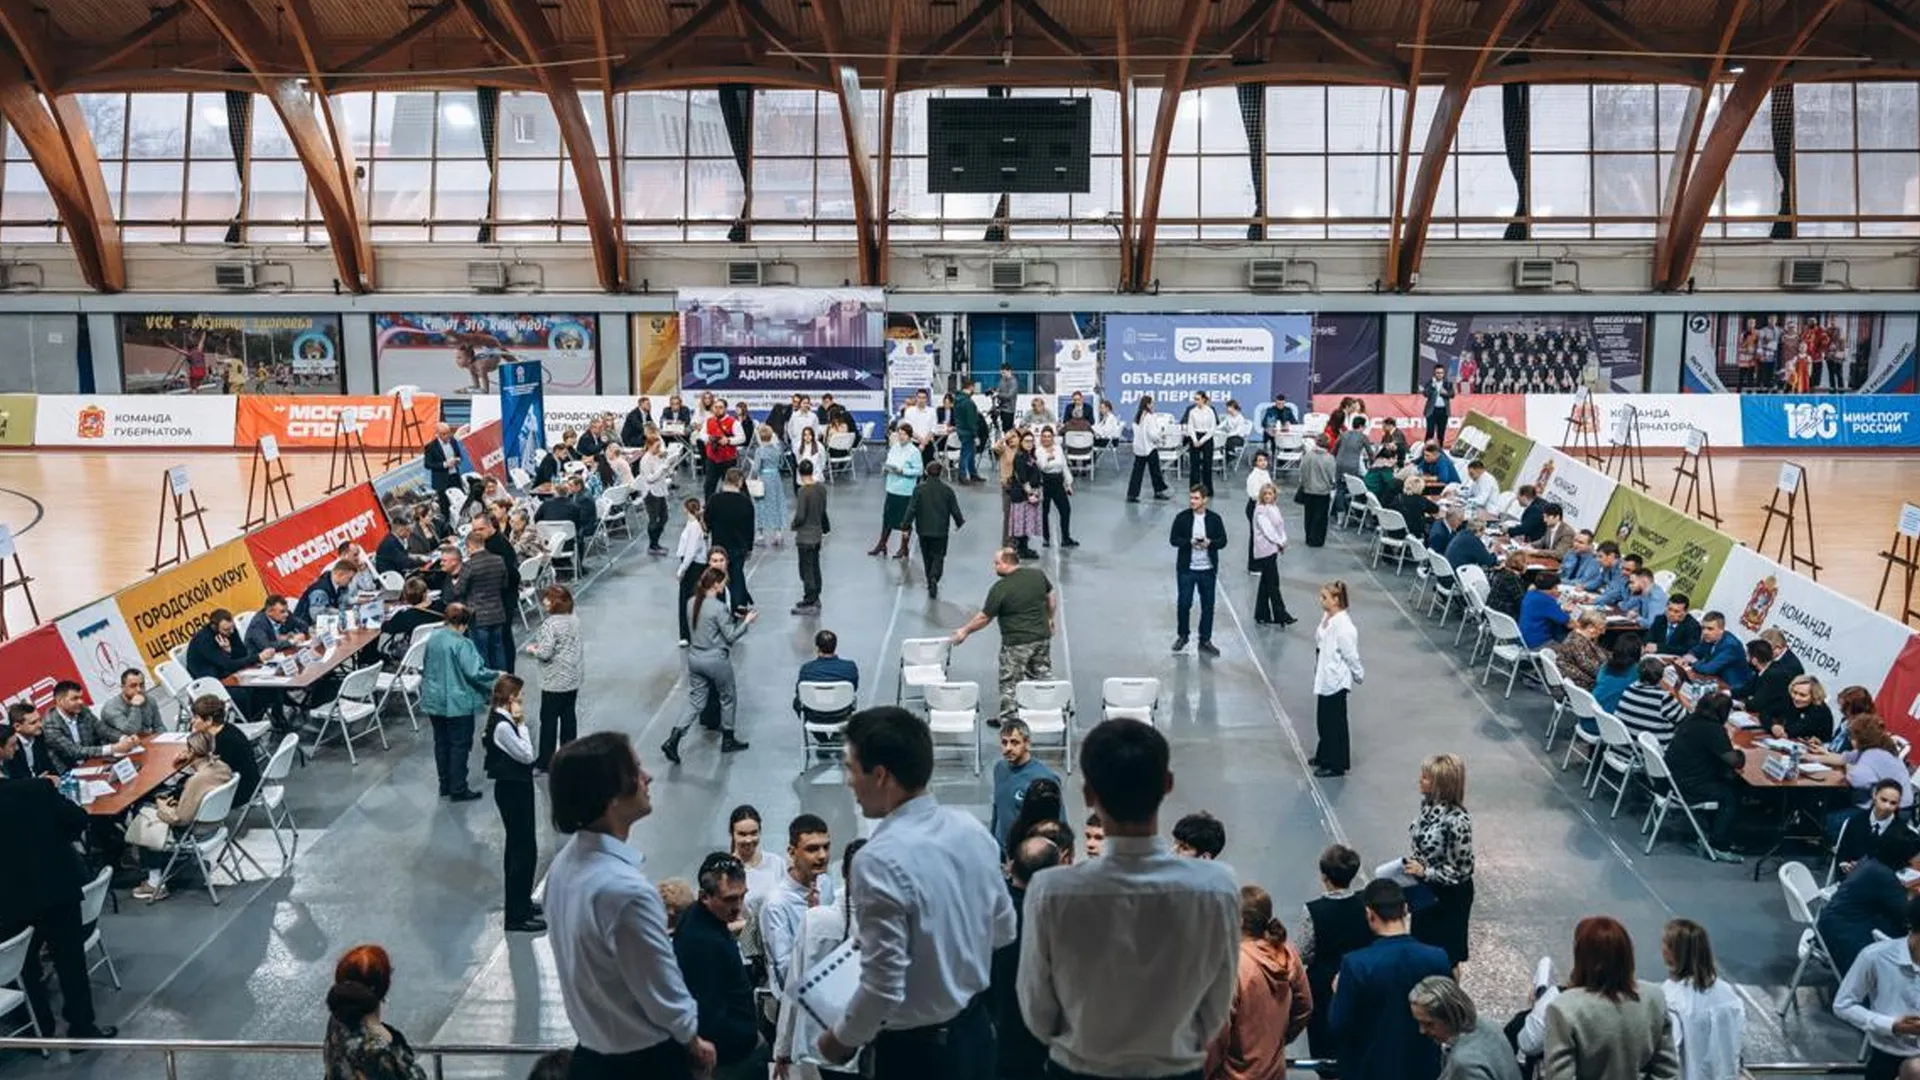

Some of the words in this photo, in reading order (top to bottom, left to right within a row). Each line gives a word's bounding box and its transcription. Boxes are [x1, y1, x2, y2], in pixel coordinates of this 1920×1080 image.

[738, 355, 807, 366] ВЫЕЗДНАЯ
[738, 369, 849, 381] АДМИНИСТРАЦИЯ
[1121, 372, 1253, 386] ОБЪЕДИНЯЕМСЯ
[1158, 390, 1233, 403] ПЕРЕЕН
[115, 414, 172, 425] КОМАНДА
[1610, 409, 1670, 418] КОАНДА
[1842, 411, 1910, 423] МИНСПОРТ
[114, 427, 192, 438] ГУБЕРНАТОРА
[288, 422, 368, 438] СПОТ
[1852, 423, 1902, 434] РОССИИ
[273, 508, 377, 577] МОСОБЛСПОРТ
[134, 579, 213, 633] ГОРОДСКОЙ
[212, 562, 249, 593] ОКРУГ
[1779, 601, 1833, 641] КОМАНДА
